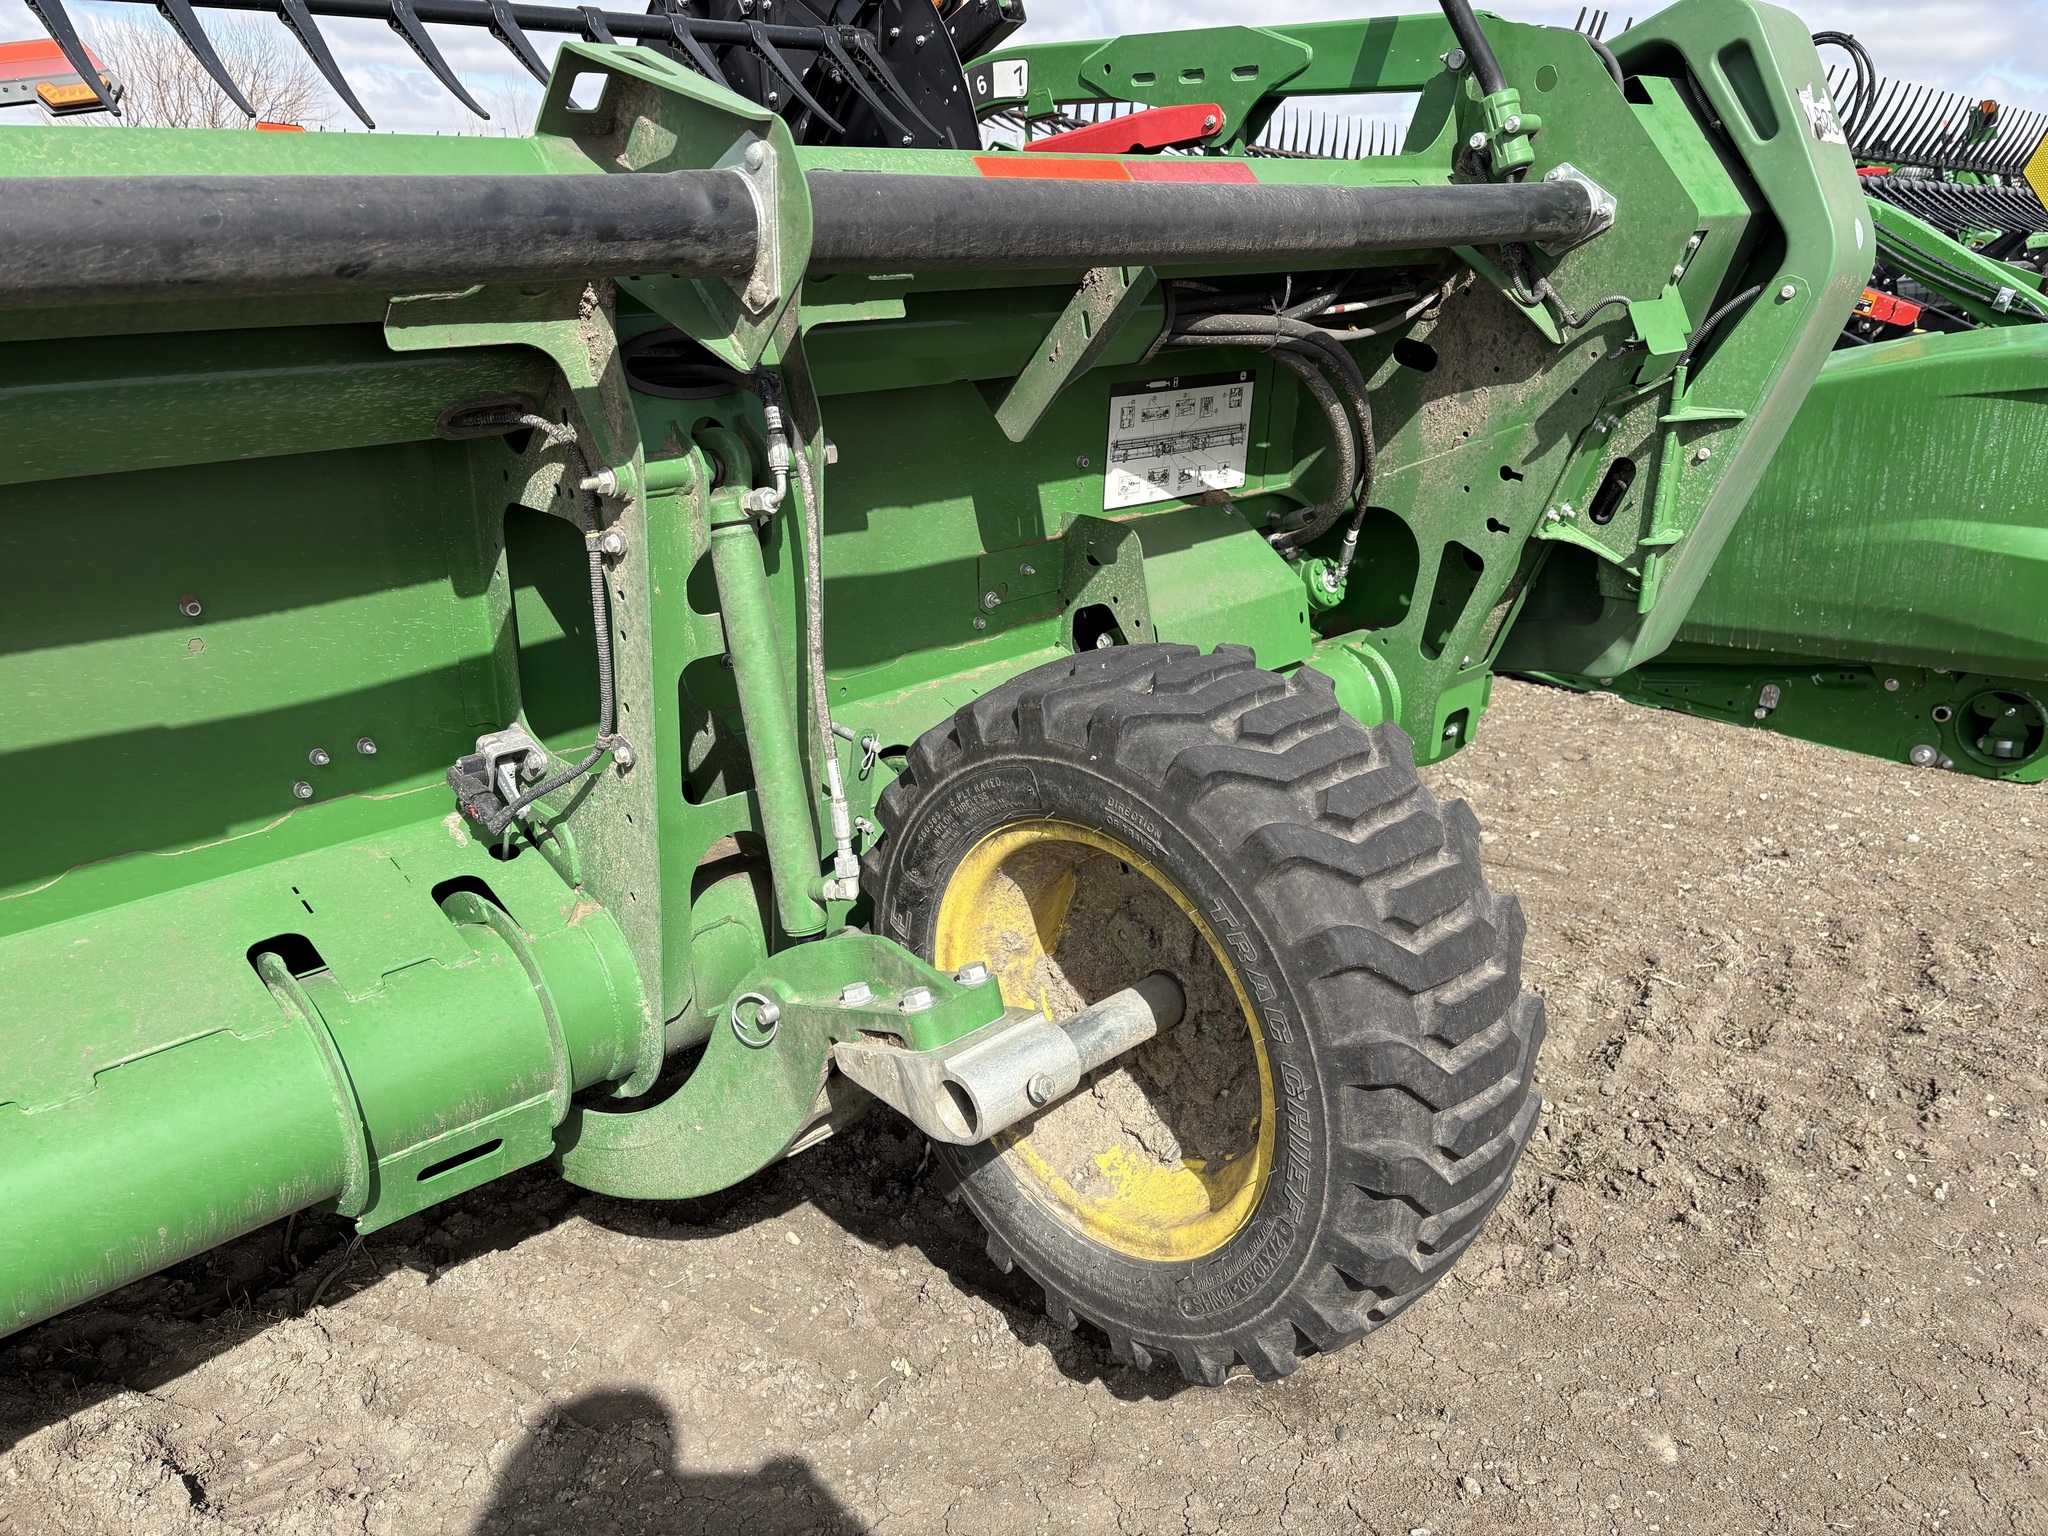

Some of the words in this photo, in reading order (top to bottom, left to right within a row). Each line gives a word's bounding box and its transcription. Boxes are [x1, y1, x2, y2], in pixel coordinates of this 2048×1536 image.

[976, 75, 987, 95] 6
[956, 786, 971, 802] PLY
[973, 776, 1001, 792] RATED
[932, 812, 955, 837] NYLON
[952, 791, 990, 817] TUBELESS
[1107, 796, 1162, 840] DIRECTION
[1106, 815, 1119, 827] OF
[1122, 824, 1157, 857] TRAVEL
[1209, 896, 1294, 1045] TRAC
[1281, 1061, 1312, 1226] CHIEF
[1260, 1217, 1272, 1237] NOT
[1249, 1235, 1263, 1252] FOR
[1223, 1249, 1252, 1279] HIGHWAY
[1195, 1272, 1222, 1291] SERVICE
